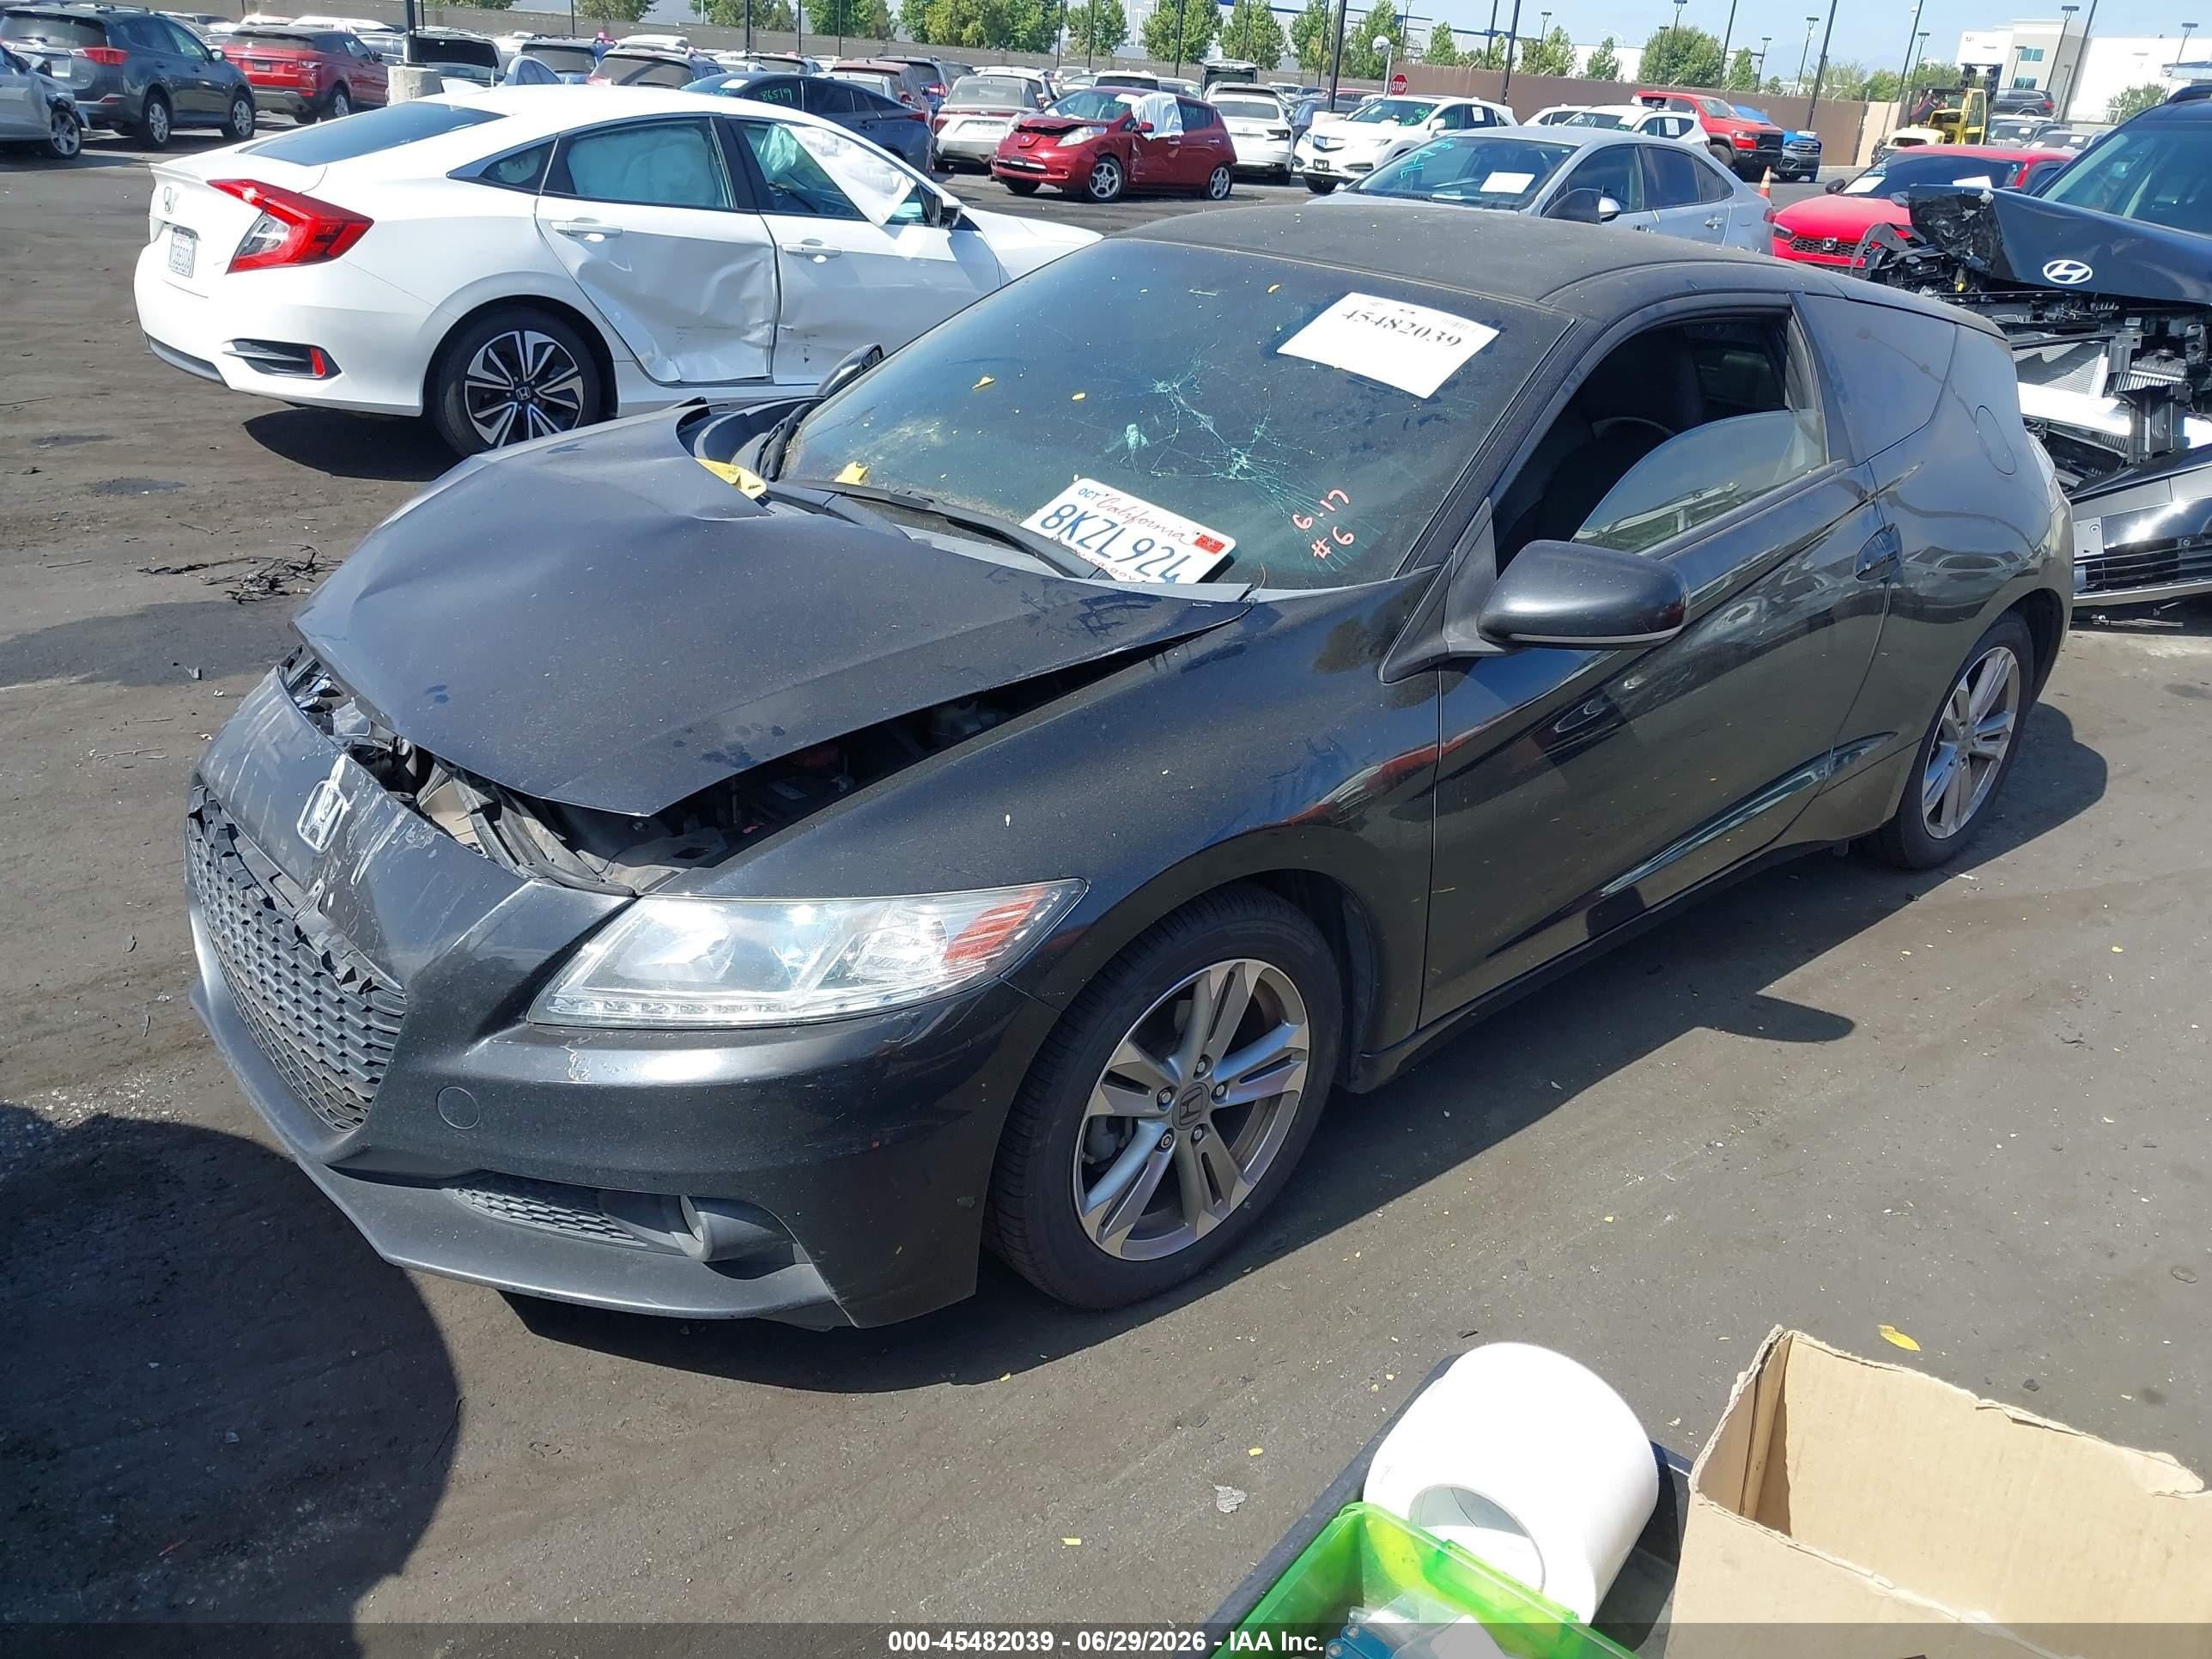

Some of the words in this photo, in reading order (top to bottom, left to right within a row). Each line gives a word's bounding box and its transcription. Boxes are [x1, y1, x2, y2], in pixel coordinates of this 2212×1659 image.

[761, 88, 793, 103] 86519
[1391, 81, 1407, 92] STOP
[1342, 310, 1462, 346] 45482039
[1078, 488, 1101, 501] OCT
[1096, 496, 1194, 546] California
[1040, 503, 1191, 584] 8KZL924
[1311, 526, 1354, 559] #6
